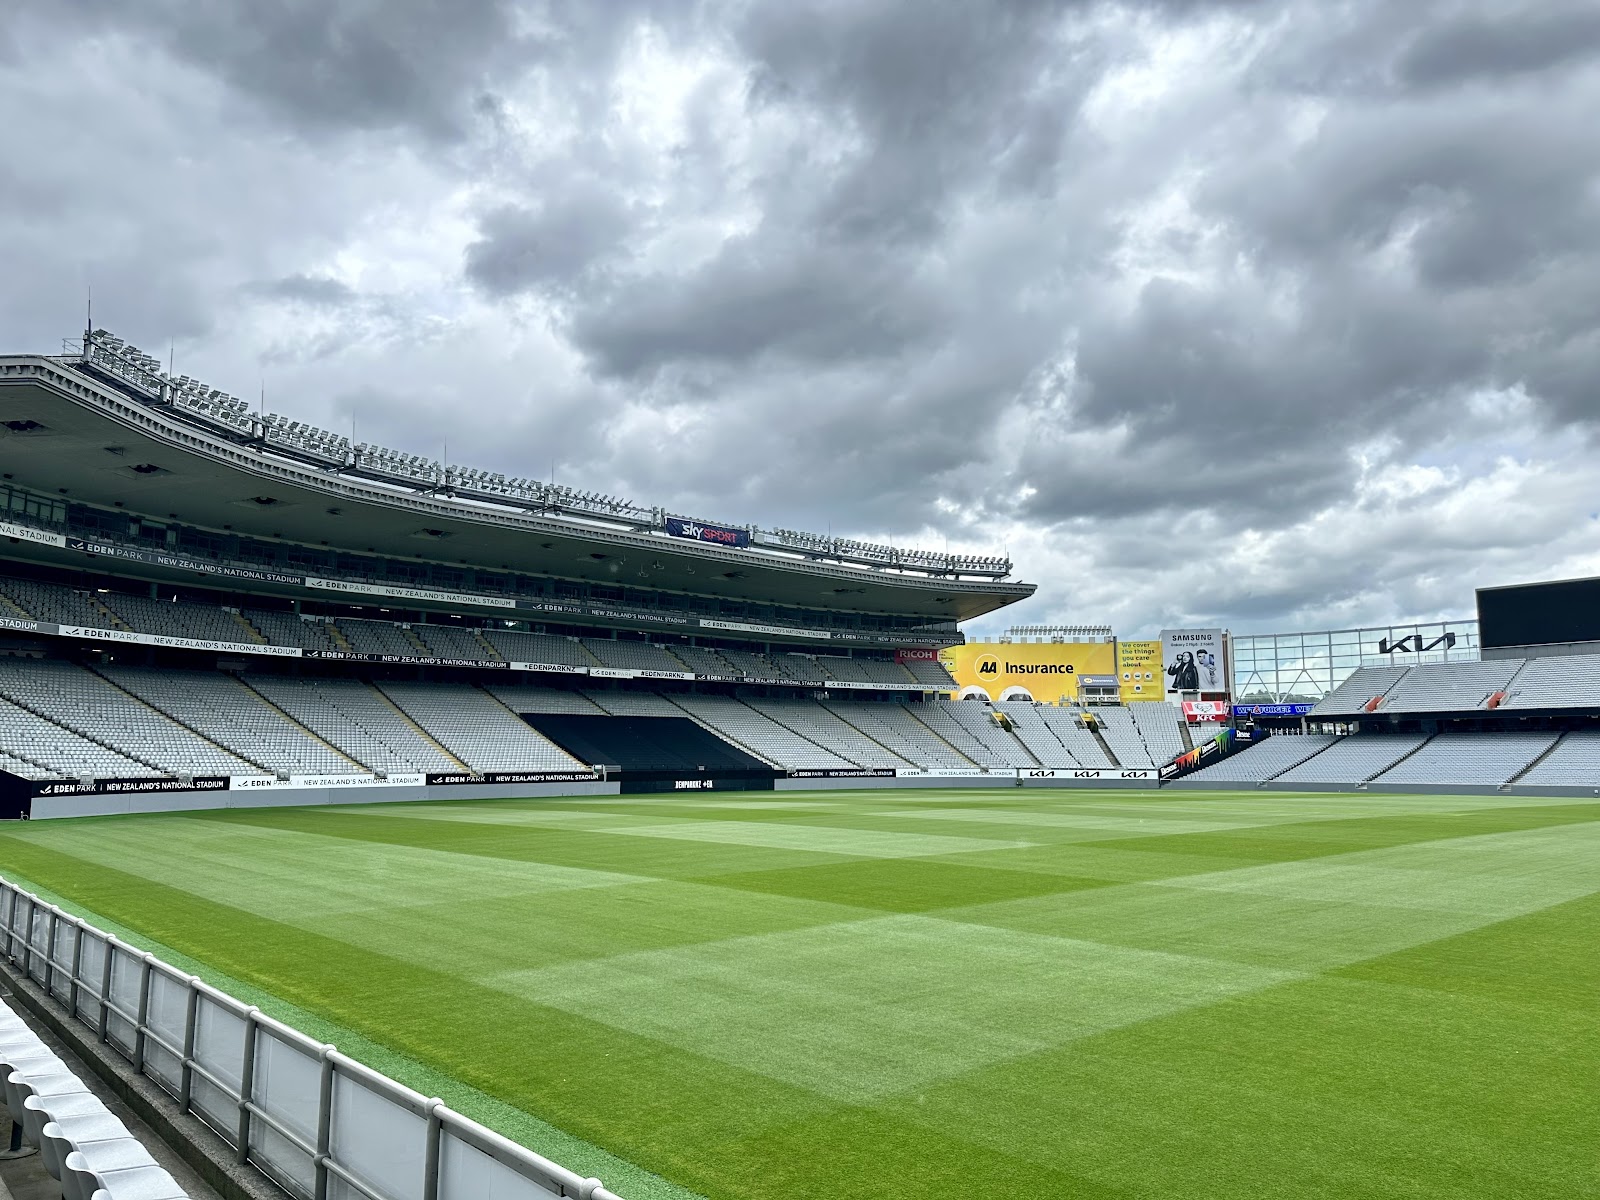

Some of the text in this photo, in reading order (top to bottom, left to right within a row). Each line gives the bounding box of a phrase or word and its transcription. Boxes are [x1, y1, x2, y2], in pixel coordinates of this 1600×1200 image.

[19, 529, 58, 543] STADIUM
[681, 522, 737, 543] sky SPORT
[87, 543, 300, 584] EDEN PARK NEW ZEALAND'S NATIONAL STADIUM
[325, 581, 511, 606] EDEN PARK NEW ZEALAND'S NATIONAL STADIUM
[544, 604, 563, 612] EDEN
[564, 606, 582, 614] PARK
[606, 611, 637, 619] ZEALAND'S
[637, 614, 664, 622] NATIONAL
[0, 619, 37, 630] STADIUM
[84, 629, 297, 656] EDEN PARK NEW ZEALAND'S NATIONAL STADIUM
[1379, 632, 1456, 654] KIA
[321, 651, 344, 659] EDEN
[401, 656, 441, 665] ZEALAND'S
[442, 659, 477, 667] NATIONAL
[900, 650, 933, 659] RICOH
[980, 662, 1074, 674] AA Insurance
[1201, 740, 1217, 754] Resene
[1160, 763, 1178, 776] Resene
[54, 780, 224, 793] EDEN PARK NEW ZEALAND'S NATIONAL STADIUM
